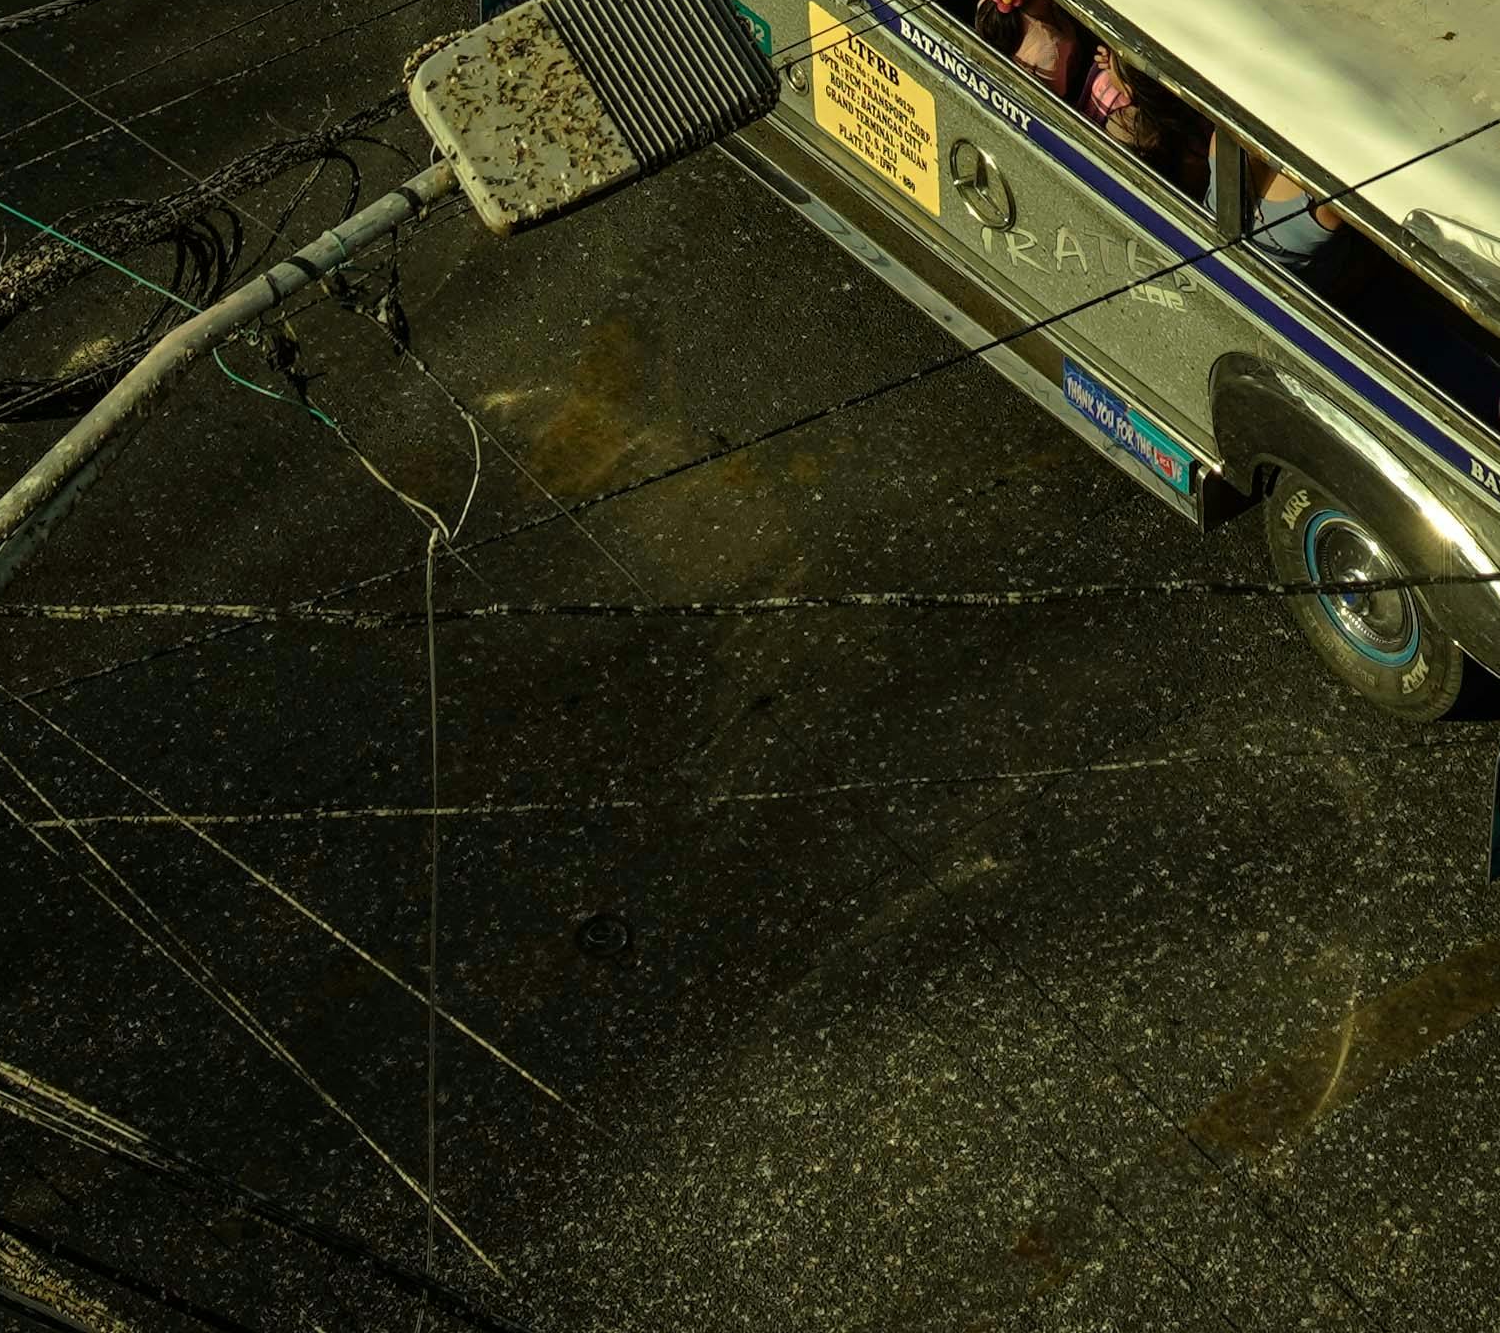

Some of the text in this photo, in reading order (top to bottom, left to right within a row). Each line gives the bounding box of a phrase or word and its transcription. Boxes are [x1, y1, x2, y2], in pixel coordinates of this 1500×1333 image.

[834, 47, 854, 69] CASE
[847, 32, 900, 86] LTFRB
[900, 18, 1032, 131] BATANGAS CITY
[826, 85, 854, 114] GRAND
[855, 107, 895, 147] TERMINAL
[900, 143, 928, 172] BAUAN
[830, 72, 856, 101] ROUTE
[861, 96, 903, 137] BATANGAS
[904, 130, 923, 154] CITY
[863, 84, 909, 126] TRANSPORT
[839, 123, 864, 152] PLATE
[1067, 377, 1095, 415] THANK
[1095, 399, 1114, 429] YOU
[1116, 417, 1134, 446] FOR
[1281, 489, 1311, 530] MRF
